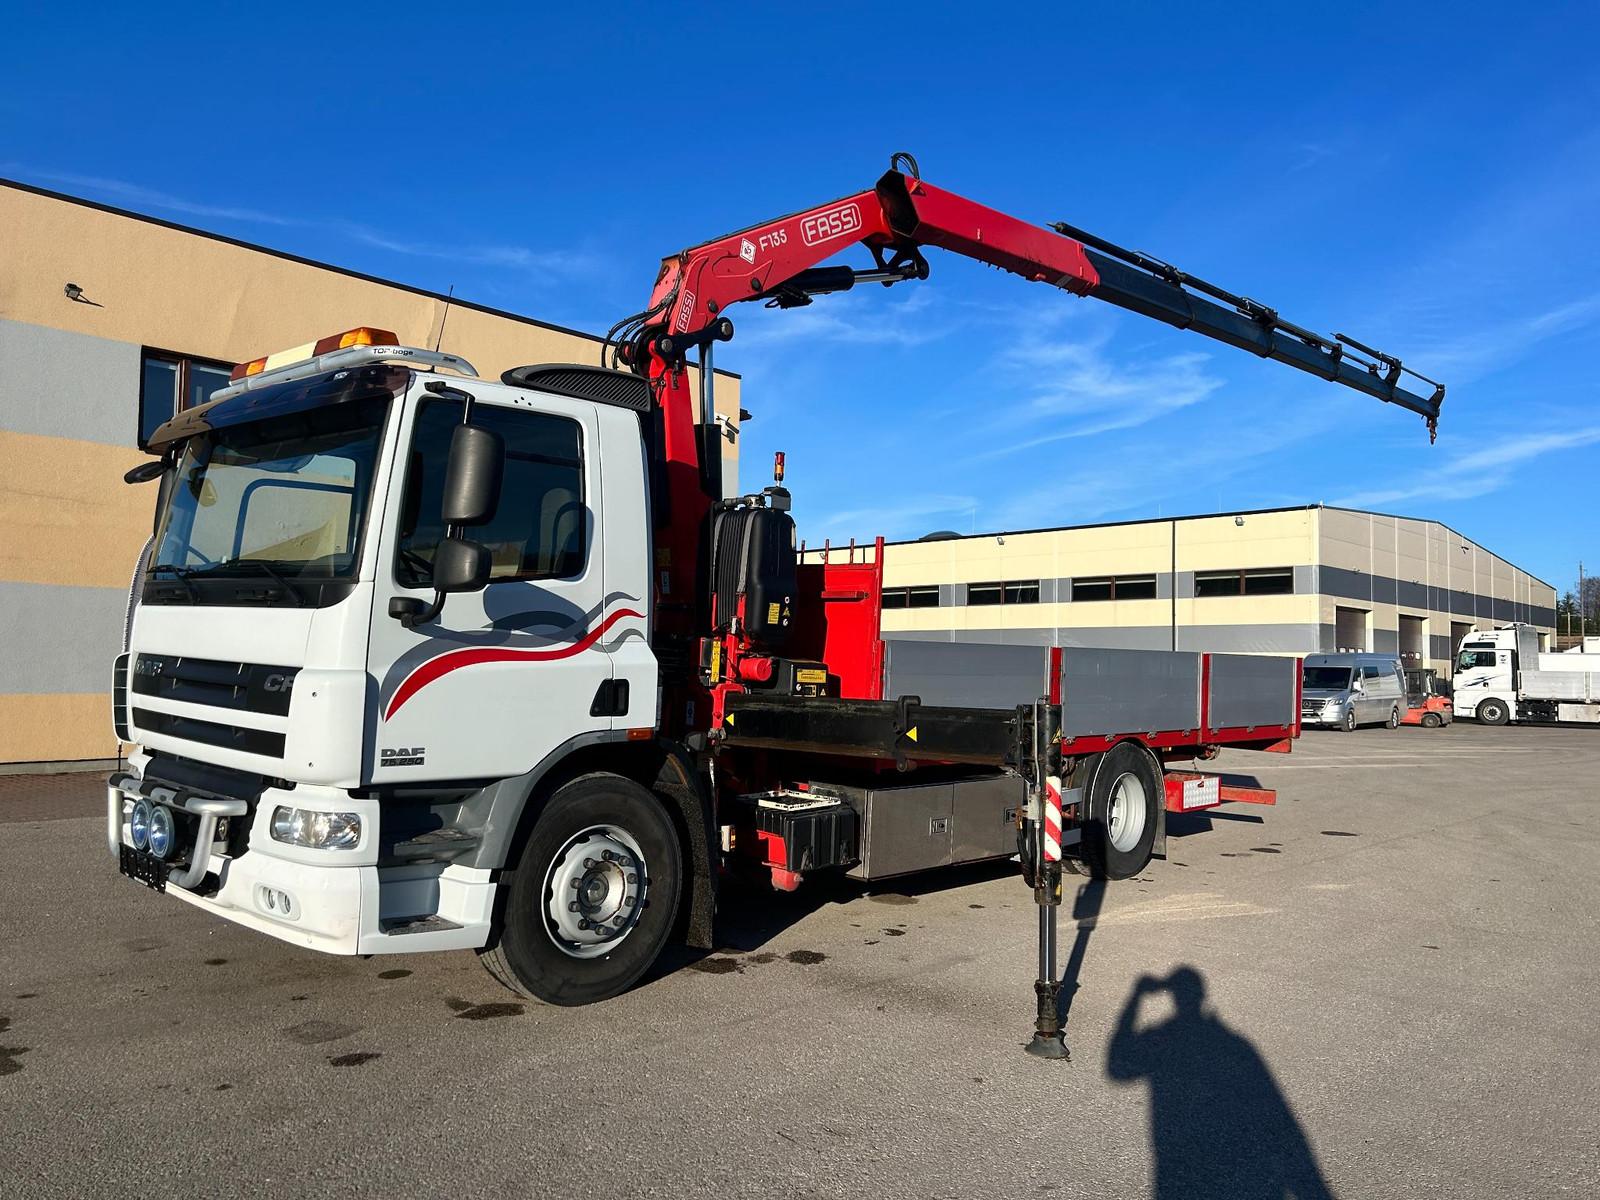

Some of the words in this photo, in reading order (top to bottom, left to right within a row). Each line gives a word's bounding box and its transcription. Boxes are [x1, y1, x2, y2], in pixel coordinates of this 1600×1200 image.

[804, 207, 858, 242] FASSI
[758, 228, 788, 252] F135
[678, 293, 694, 330] FASSI
[381, 747, 426, 758] DAF
